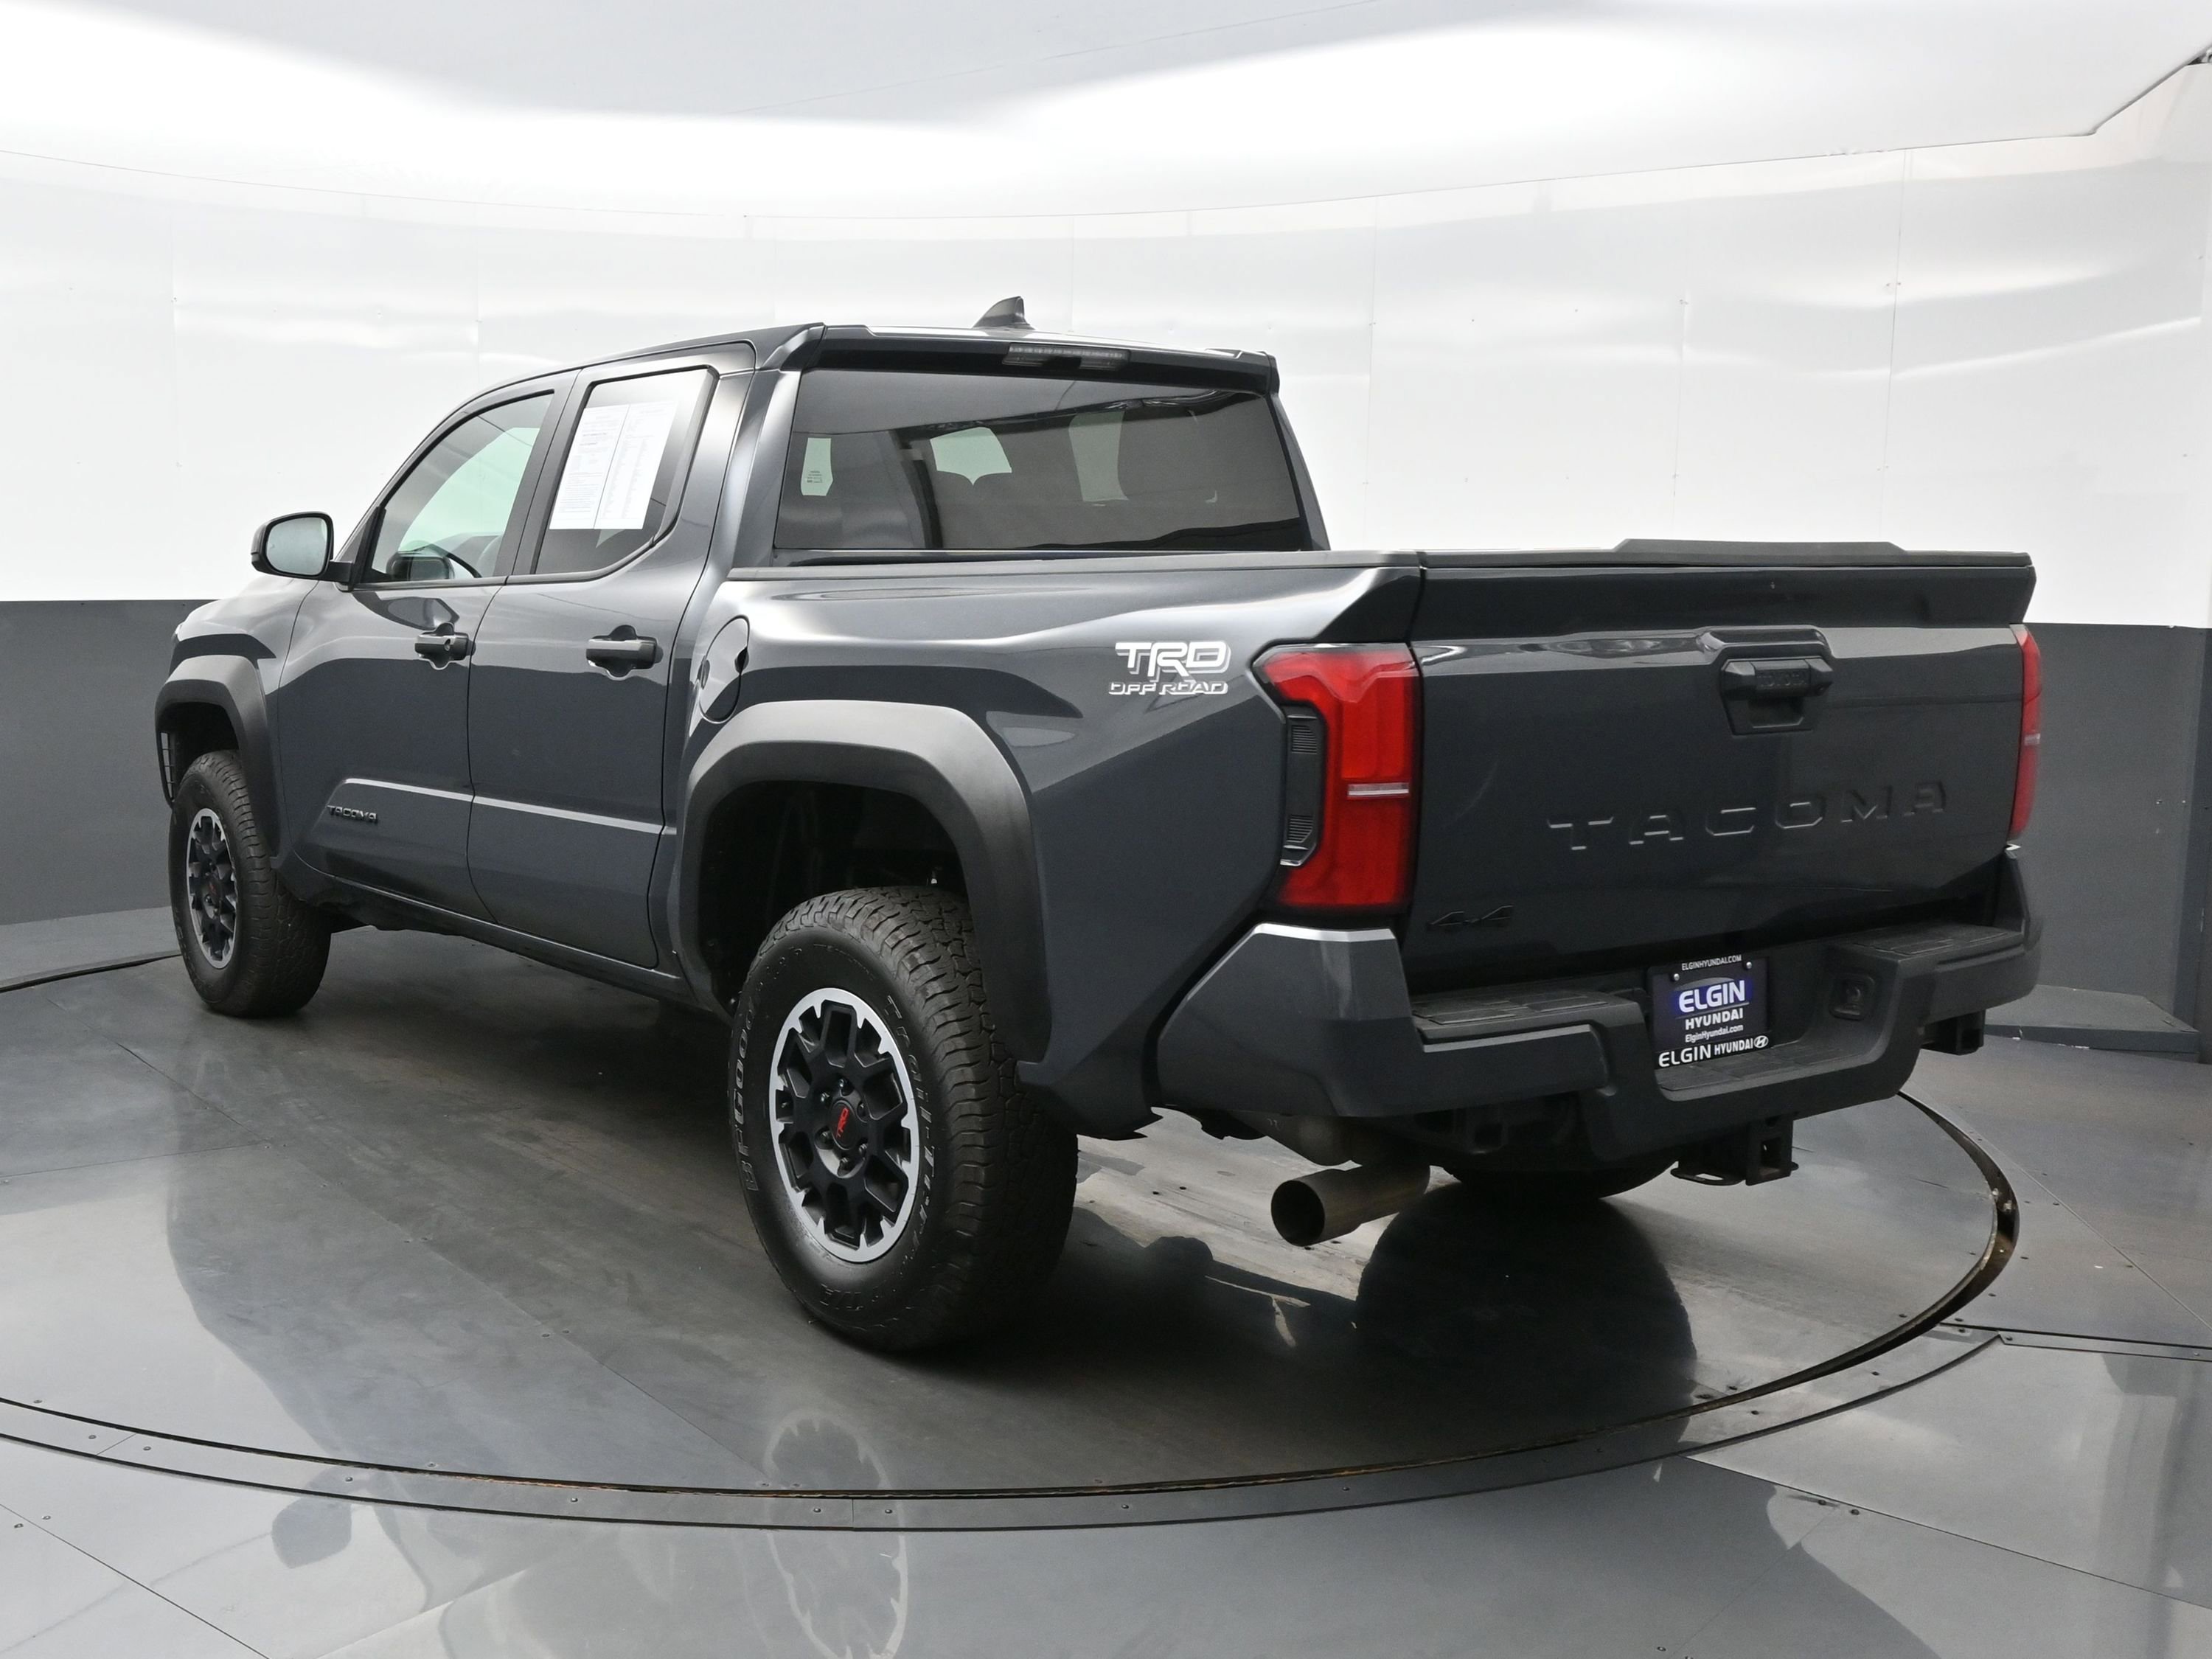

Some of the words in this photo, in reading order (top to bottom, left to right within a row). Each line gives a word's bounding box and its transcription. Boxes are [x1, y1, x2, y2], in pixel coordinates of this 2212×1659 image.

[1115, 641, 1231, 683] TRD
[1108, 681, 1156, 695] OFF
[1159, 681, 1228, 695] ROAD
[327, 804, 378, 824] TACOMA
[1548, 782, 1947, 851] TACOMA
[1682, 955, 1742, 970] ELGINHYUNDAI.COM
[1679, 980, 1745, 1012] ELGIN
[1686, 1008, 1743, 1030] HYUNDAI
[1685, 1024, 1743, 1043] ElginHyundai.com
[1659, 1044, 1711, 1067] ELGIN
[1714, 1038, 1753, 1055] HYUNDAI
[836, 1107, 849, 1138] TRD
